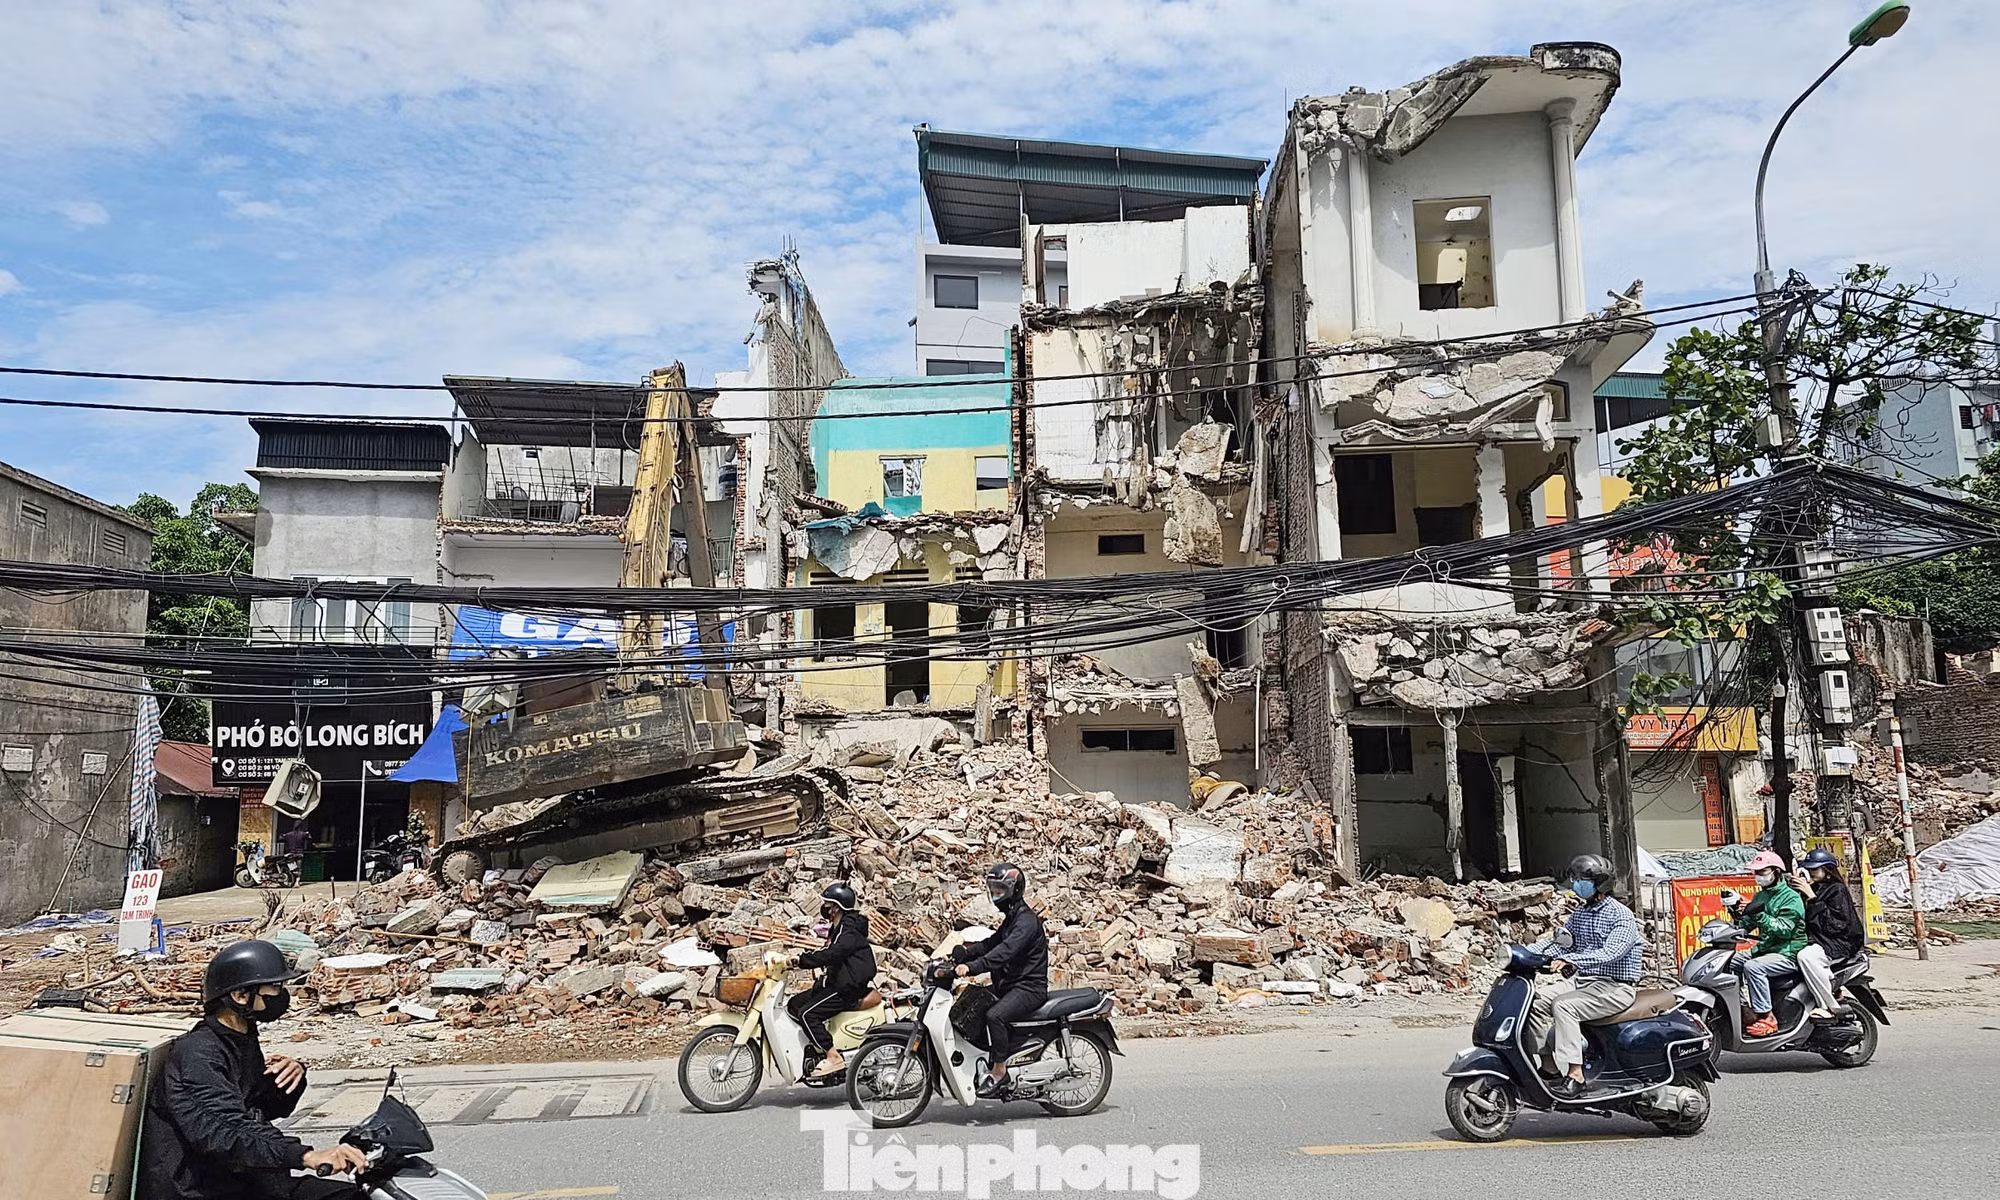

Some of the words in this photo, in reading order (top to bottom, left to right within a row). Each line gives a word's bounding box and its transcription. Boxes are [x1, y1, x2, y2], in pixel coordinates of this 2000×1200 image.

[217, 718, 265, 748] PHỞ
[270, 719, 300, 748] BÒ
[306, 725, 368, 747] LONG
[373, 719, 424, 746] BÍCH
[484, 722, 642, 768] KOMATSU
[132, 895, 149, 907] 123
